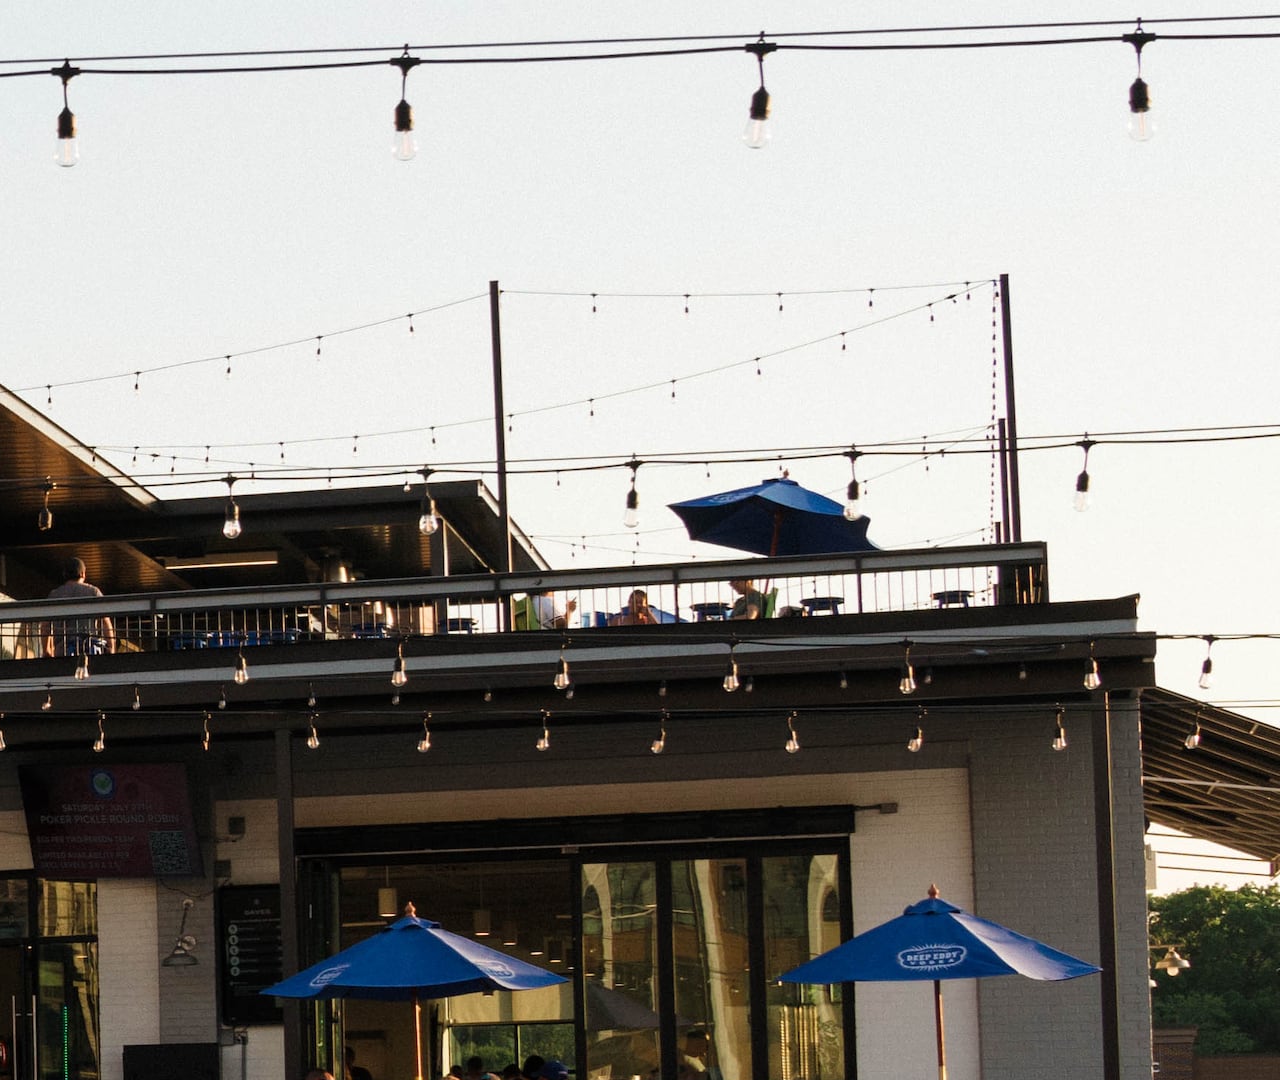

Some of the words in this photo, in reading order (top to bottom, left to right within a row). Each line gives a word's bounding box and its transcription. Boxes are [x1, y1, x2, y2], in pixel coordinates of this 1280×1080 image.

[40, 814, 72, 825] POKER
[74, 814, 107, 825] PICKLE
[109, 813, 145, 825] ROUND
[147, 813, 180, 824] ROBIN
[933, 951, 959, 960] EDDY
